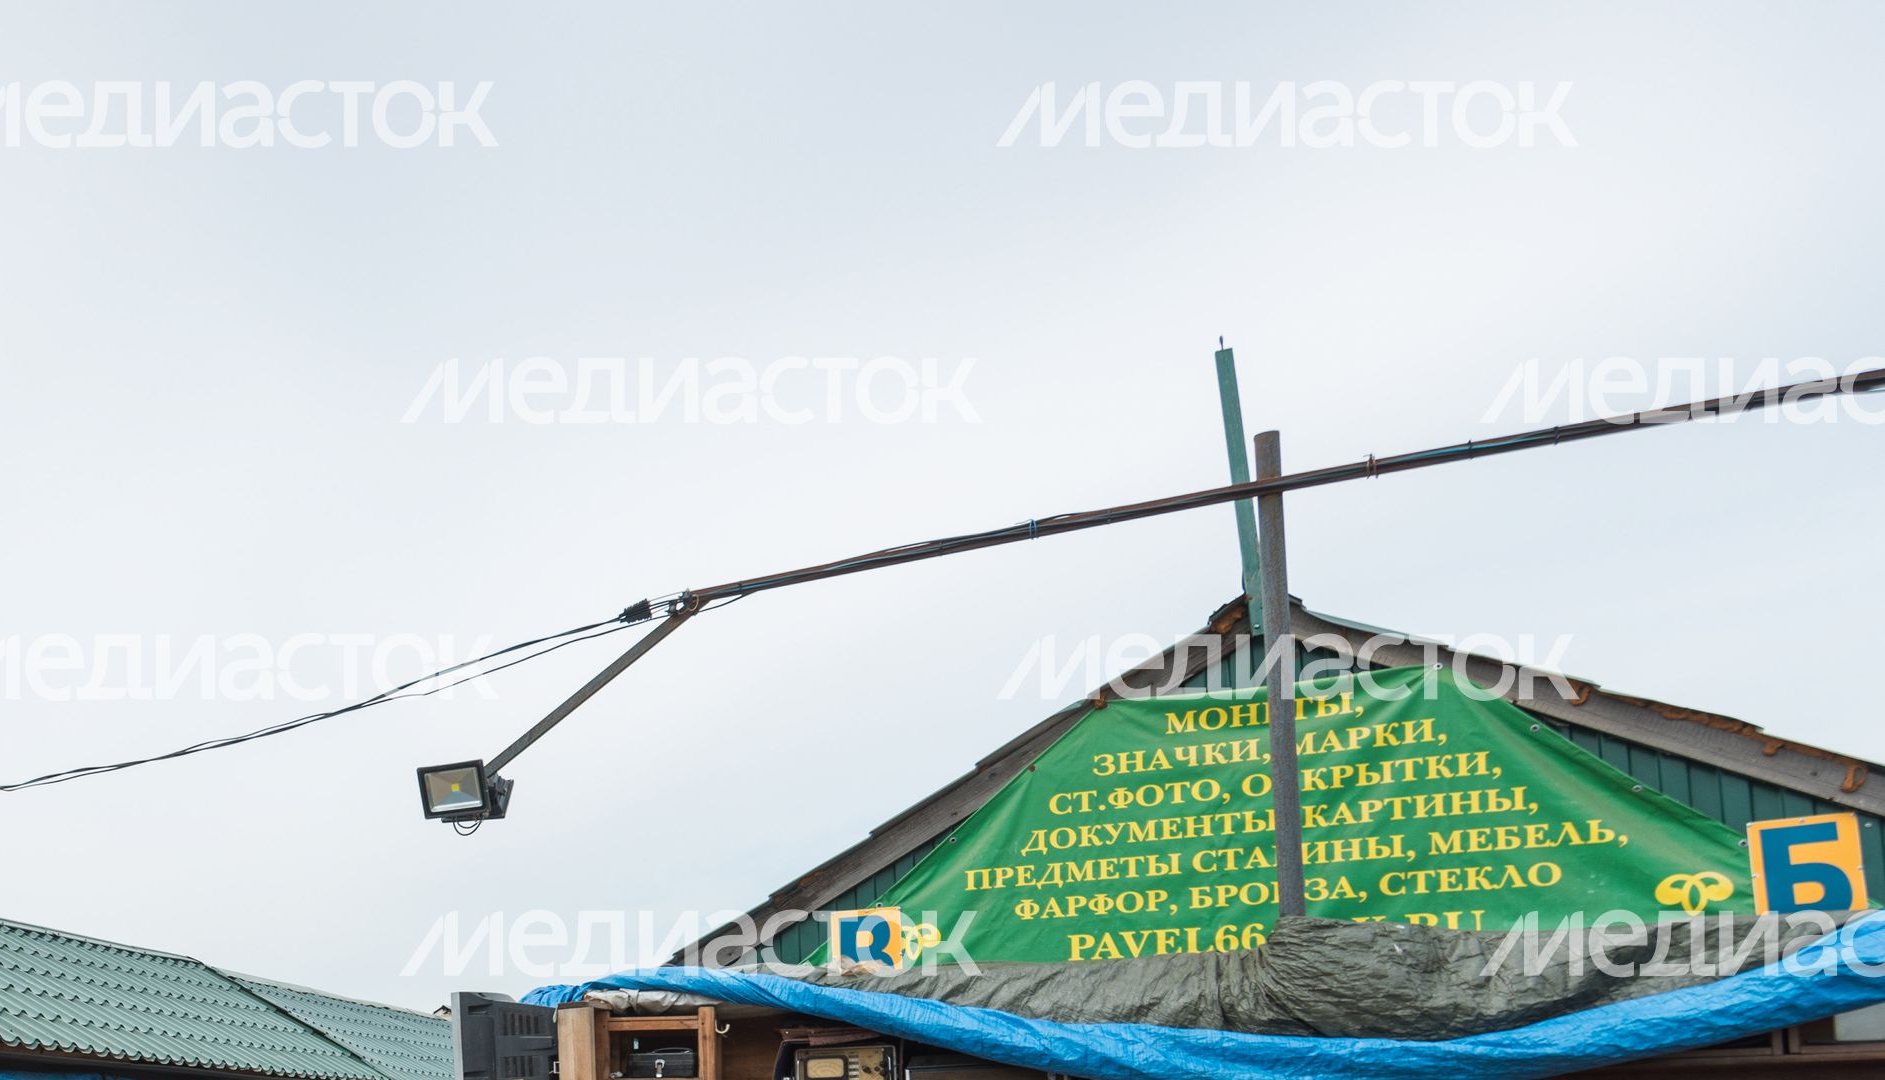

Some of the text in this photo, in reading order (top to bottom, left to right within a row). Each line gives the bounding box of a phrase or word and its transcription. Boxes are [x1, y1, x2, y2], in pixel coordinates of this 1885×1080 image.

[1166, 691, 1364, 735] МОНТЫ,
[1048, 751, 1503, 816] СТ.ФОТО, ОКРЫТКИ,
[1092, 738, 1272, 776] ЗНАЧКИ,
[1301, 786, 1539, 829] КАРТИНЫ,
[964, 819, 1629, 891] ПРЕДМЕТЫ СТАИНЫ, МЕБЕЛЬ,
[1759, 821, 1853, 914] Б
[1014, 889, 1179, 920] ФАРФОР,
[1378, 861, 1563, 897] СТЕКЛО
